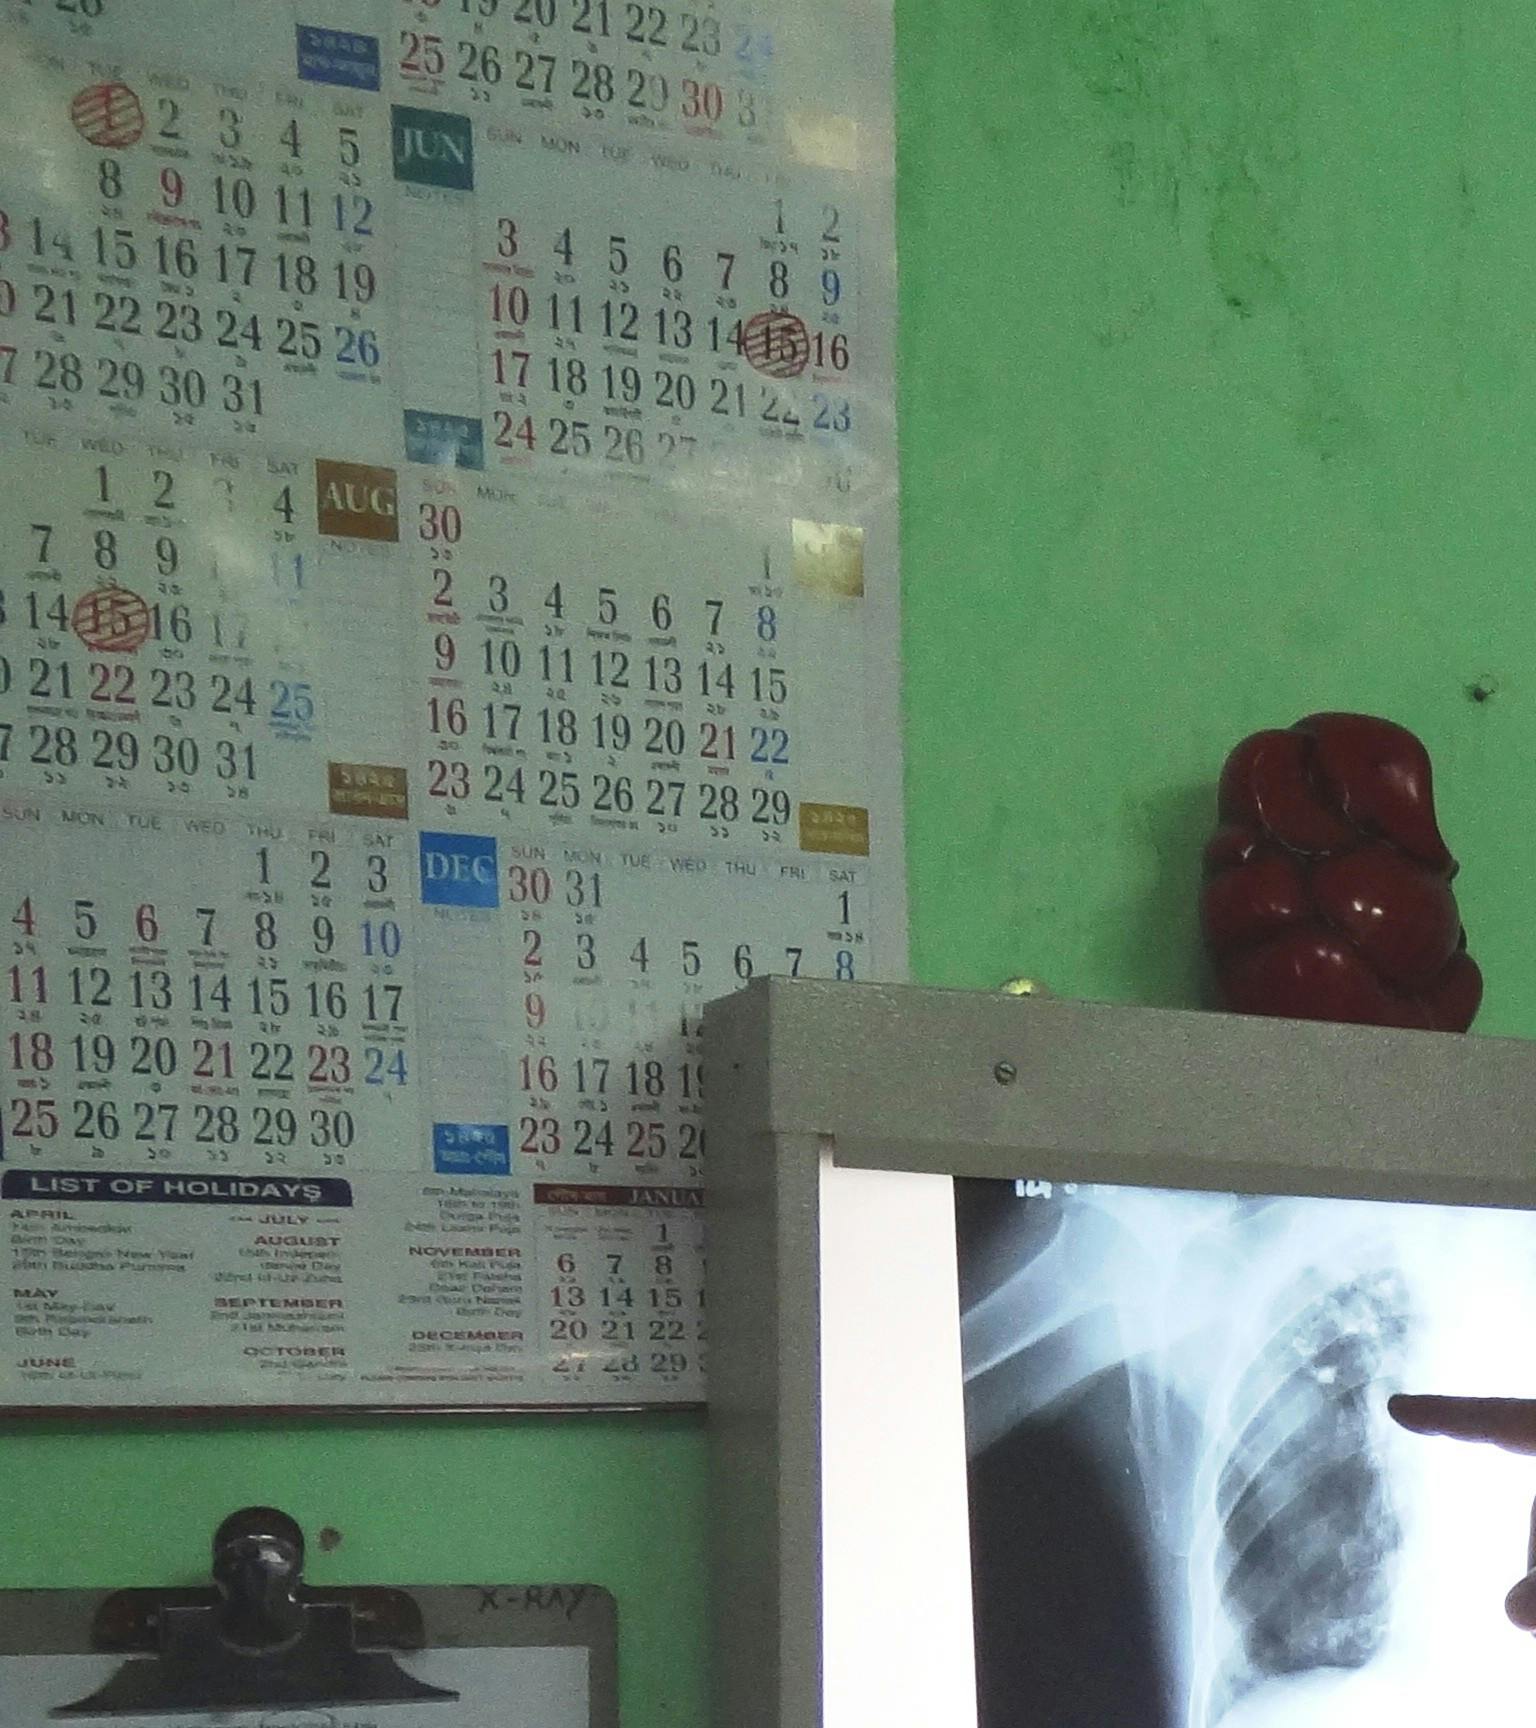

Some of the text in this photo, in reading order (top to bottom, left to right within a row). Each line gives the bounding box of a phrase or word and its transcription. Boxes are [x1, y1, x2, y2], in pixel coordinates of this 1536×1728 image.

[626, 3, 667, 45] 22
[458, 41, 614, 102] 26 27 28
[400, 129, 465, 164] JUN
[215, 243, 375, 302] 17 18 19
[34, 284, 379, 366] 21 22 23 24 25 26
[489, 281, 692, 348] 10 11 12 13
[35, 349, 262, 415] 28 29 30 31
[492, 348, 695, 410] 17 18 19 20
[494, 410, 537, 450] 24
[550, 418, 591, 458] 25
[323, 482, 394, 516] AUG
[30, 658, 256, 715] 21 22 23 24
[428, 697, 790, 765] 16 17 18 19 20 21 22
[30, 725, 257, 780] 28 29 30 31
[428, 759, 470, 799] 23
[484, 765, 525, 804] 24
[539, 769, 580, 808] 25
[593, 774, 634, 813] 26
[647, 779, 685, 816] 27
[700, 783, 738, 821] 28
[751, 788, 790, 825] 29
[363, 834, 392, 847] SAT
[311, 850, 387, 892] 2 3
[425, 851, 493, 884] DEC
[511, 847, 545, 861] SUN
[620, 854, 651, 870] TUE
[670, 858, 707, 872] WED
[726, 861, 756, 877] THU
[829, 869, 856, 883] SAT
[508, 866, 601, 908] 30 31
[75, 901, 158, 942] 5 6
[8, 965, 402, 1021] 11 12 13 14 15 16 17
[9, 1032, 407, 1085] 18 19 20 21 22 23 24
[520, 1054, 665, 1097] 16 17 18
[11, 1099, 354, 1148] 25 26 27 28 29 30
[520, 1116, 560, 1154] 23
[573, 1120, 613, 1157] 24
[627, 1120, 667, 1158] 25
[32, 1177, 322, 1201] LIST OF HOLIDAYS
[629, 1189, 703, 1205] JANUA
[10, 1209, 74, 1220] APRIL
[259, 1215, 309, 1225] JULY
[255, 1236, 341, 1247] AUGUST
[409, 1246, 521, 1258] NOVEMBER
[14, 1288, 58, 1299] MAY
[213, 1298, 343, 1309] SEPTEMBER
[600, 1287, 681, 1307] 14 15
[413, 1330, 523, 1342] DECEMBER
[551, 1320, 685, 1340] 20 21 22
[17, 1357, 76, 1369] JUNE
[243, 1347, 345, 1358] OCTOBER
